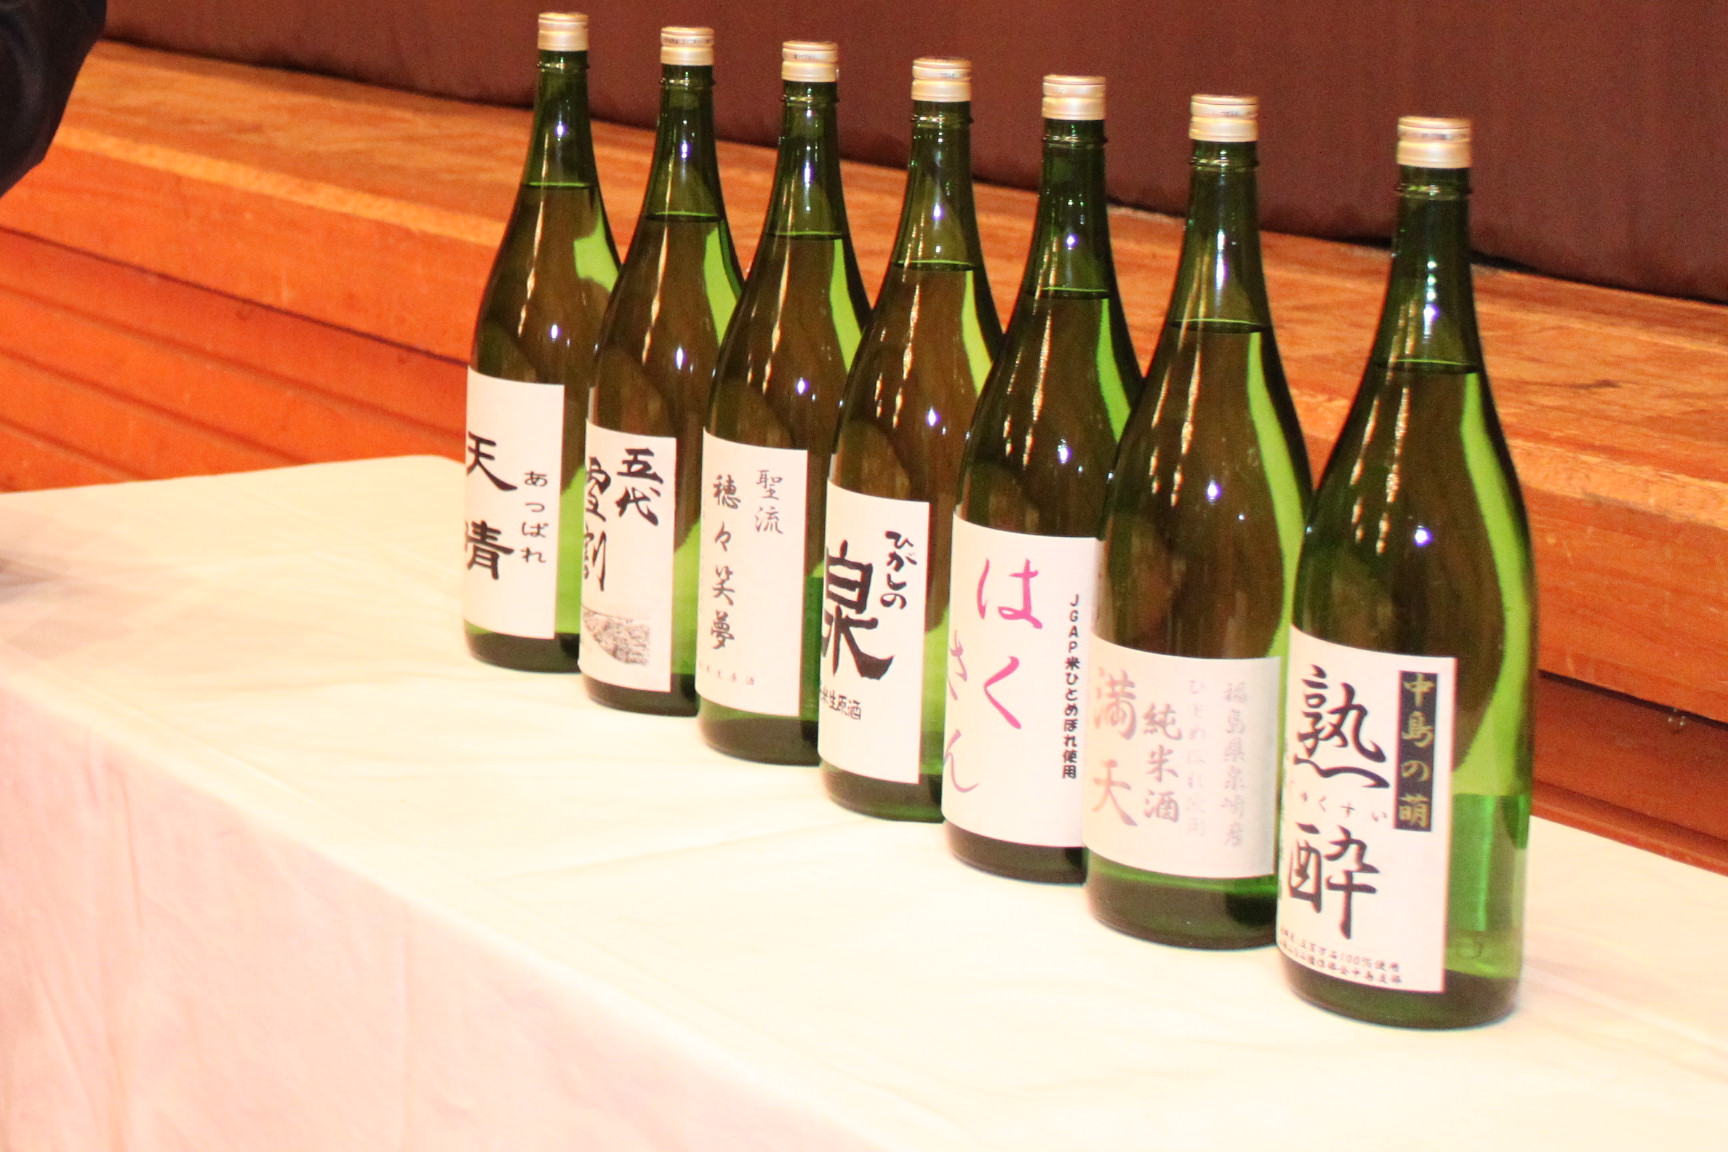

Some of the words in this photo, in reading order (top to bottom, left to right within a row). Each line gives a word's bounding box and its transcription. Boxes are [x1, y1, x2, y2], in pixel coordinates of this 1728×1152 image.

[616, 448, 664, 527] 五代
[755, 469, 784, 535] 聖流
[711, 474, 741, 650] 穂々笑夢
[822, 539, 896, 680] 泉
[880, 530, 917, 609] ひがしの
[1092, 667, 1138, 827] 満天
[1142, 702, 1183, 823] 純米酒
